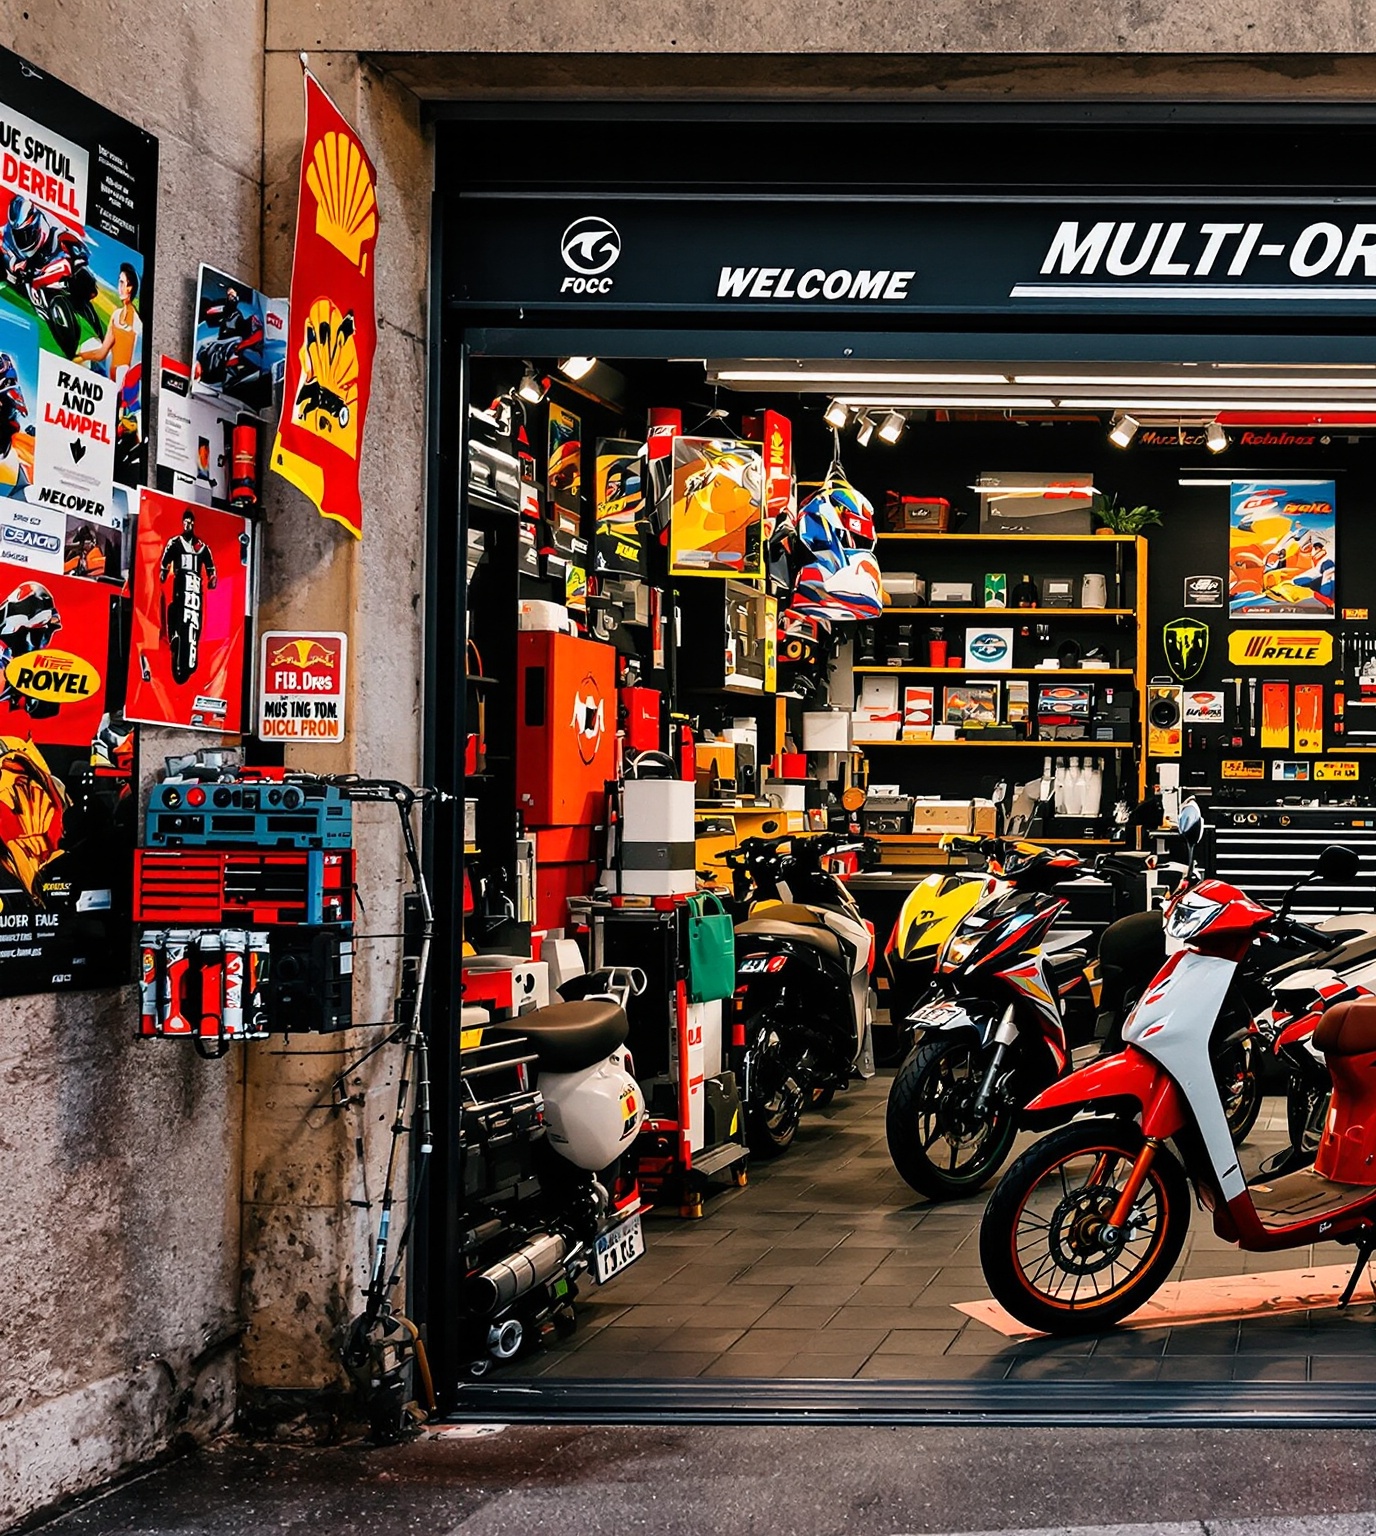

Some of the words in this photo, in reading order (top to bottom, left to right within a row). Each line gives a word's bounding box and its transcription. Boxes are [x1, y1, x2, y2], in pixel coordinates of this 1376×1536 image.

[560, 277, 613, 294] FOCC
[716, 266, 916, 300] WELCOME
[57, 371, 104, 402] RAND
[62, 392, 95, 416] AND
[45, 402, 111, 445] LAMPEL
[16, 667, 89, 695] ROYEL
